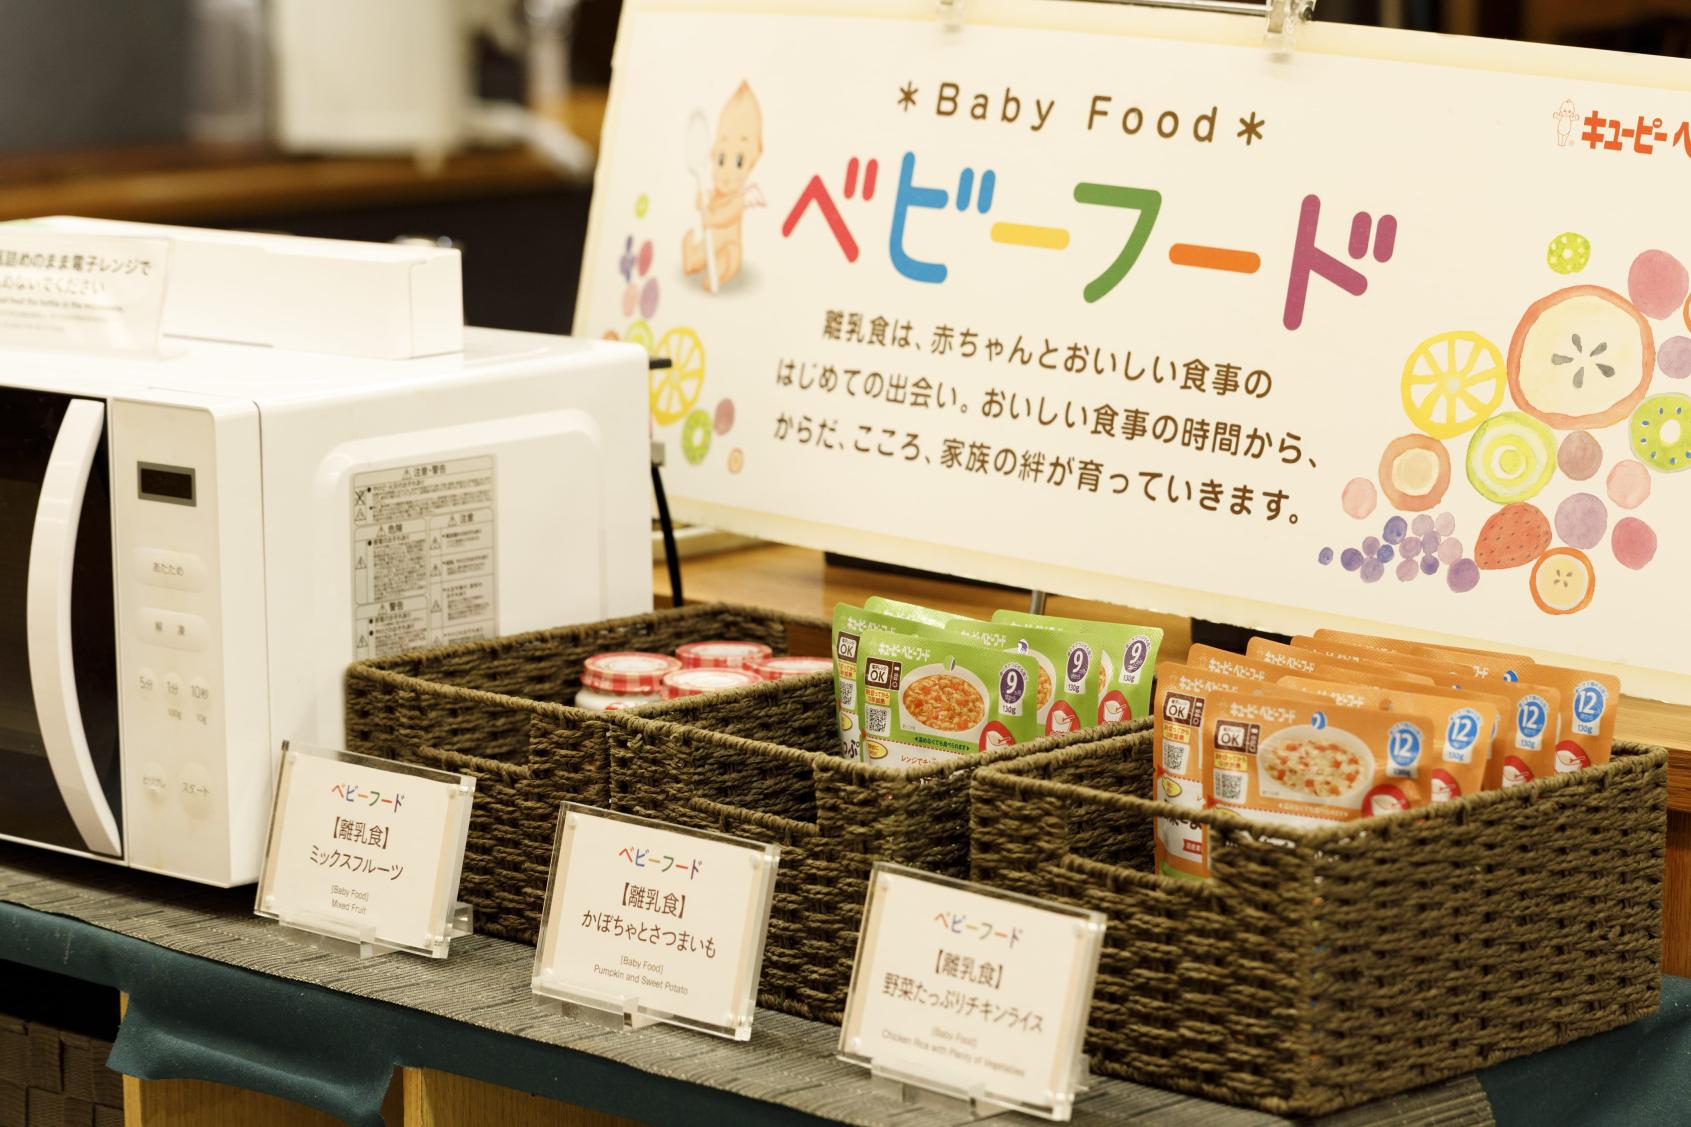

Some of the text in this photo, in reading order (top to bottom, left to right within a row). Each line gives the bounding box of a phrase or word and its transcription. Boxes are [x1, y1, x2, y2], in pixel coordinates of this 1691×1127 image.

[936, 81, 1218, 143] Baby Food
[781, 151, 1399, 331] ベビーフード
[0, 250, 152, 276] 詰めのまま電子レンジで
[822, 309, 1273, 399] 離乳食は、赤ちゃんとおいしい食事の
[776, 358, 1318, 469] はじめての出会い。おいしい食事の時間から、
[774, 412, 1300, 525] からだ、こころ、家族の絆が育っていきます。
[840, 644, 854, 658] OK
[1073, 651, 1083, 673] 9
[1130, 642, 1142, 664] 9
[871, 670, 885, 682] OK
[1007, 671, 1017, 694] 9
[1168, 705, 1185, 718] OK
[1522, 705, 1539, 729] 12
[1578, 691, 1597, 714] 12
[1221, 733, 1240, 746] OK
[1393, 732, 1413, 757] 12
[1451, 718, 1472, 741] 12
[331, 783, 405, 813] ベビーフード
[334, 816, 389, 849] 【離乳食】
[310, 845, 404, 880] ミックスフルーツ
[618, 846, 702, 880] ベビーフード
[331, 899, 367, 915] Mixed Fruit
[621, 882, 686, 919] 【離乳食】
[581, 909, 716, 959] かぼちゃとさつまいも
[934, 912, 1024, 949] ベビーフード
[593, 964, 688, 995] Pumpkin and Sweet Potato
[881, 972, 1044, 1033] 野菜たっぷりチキンライス
